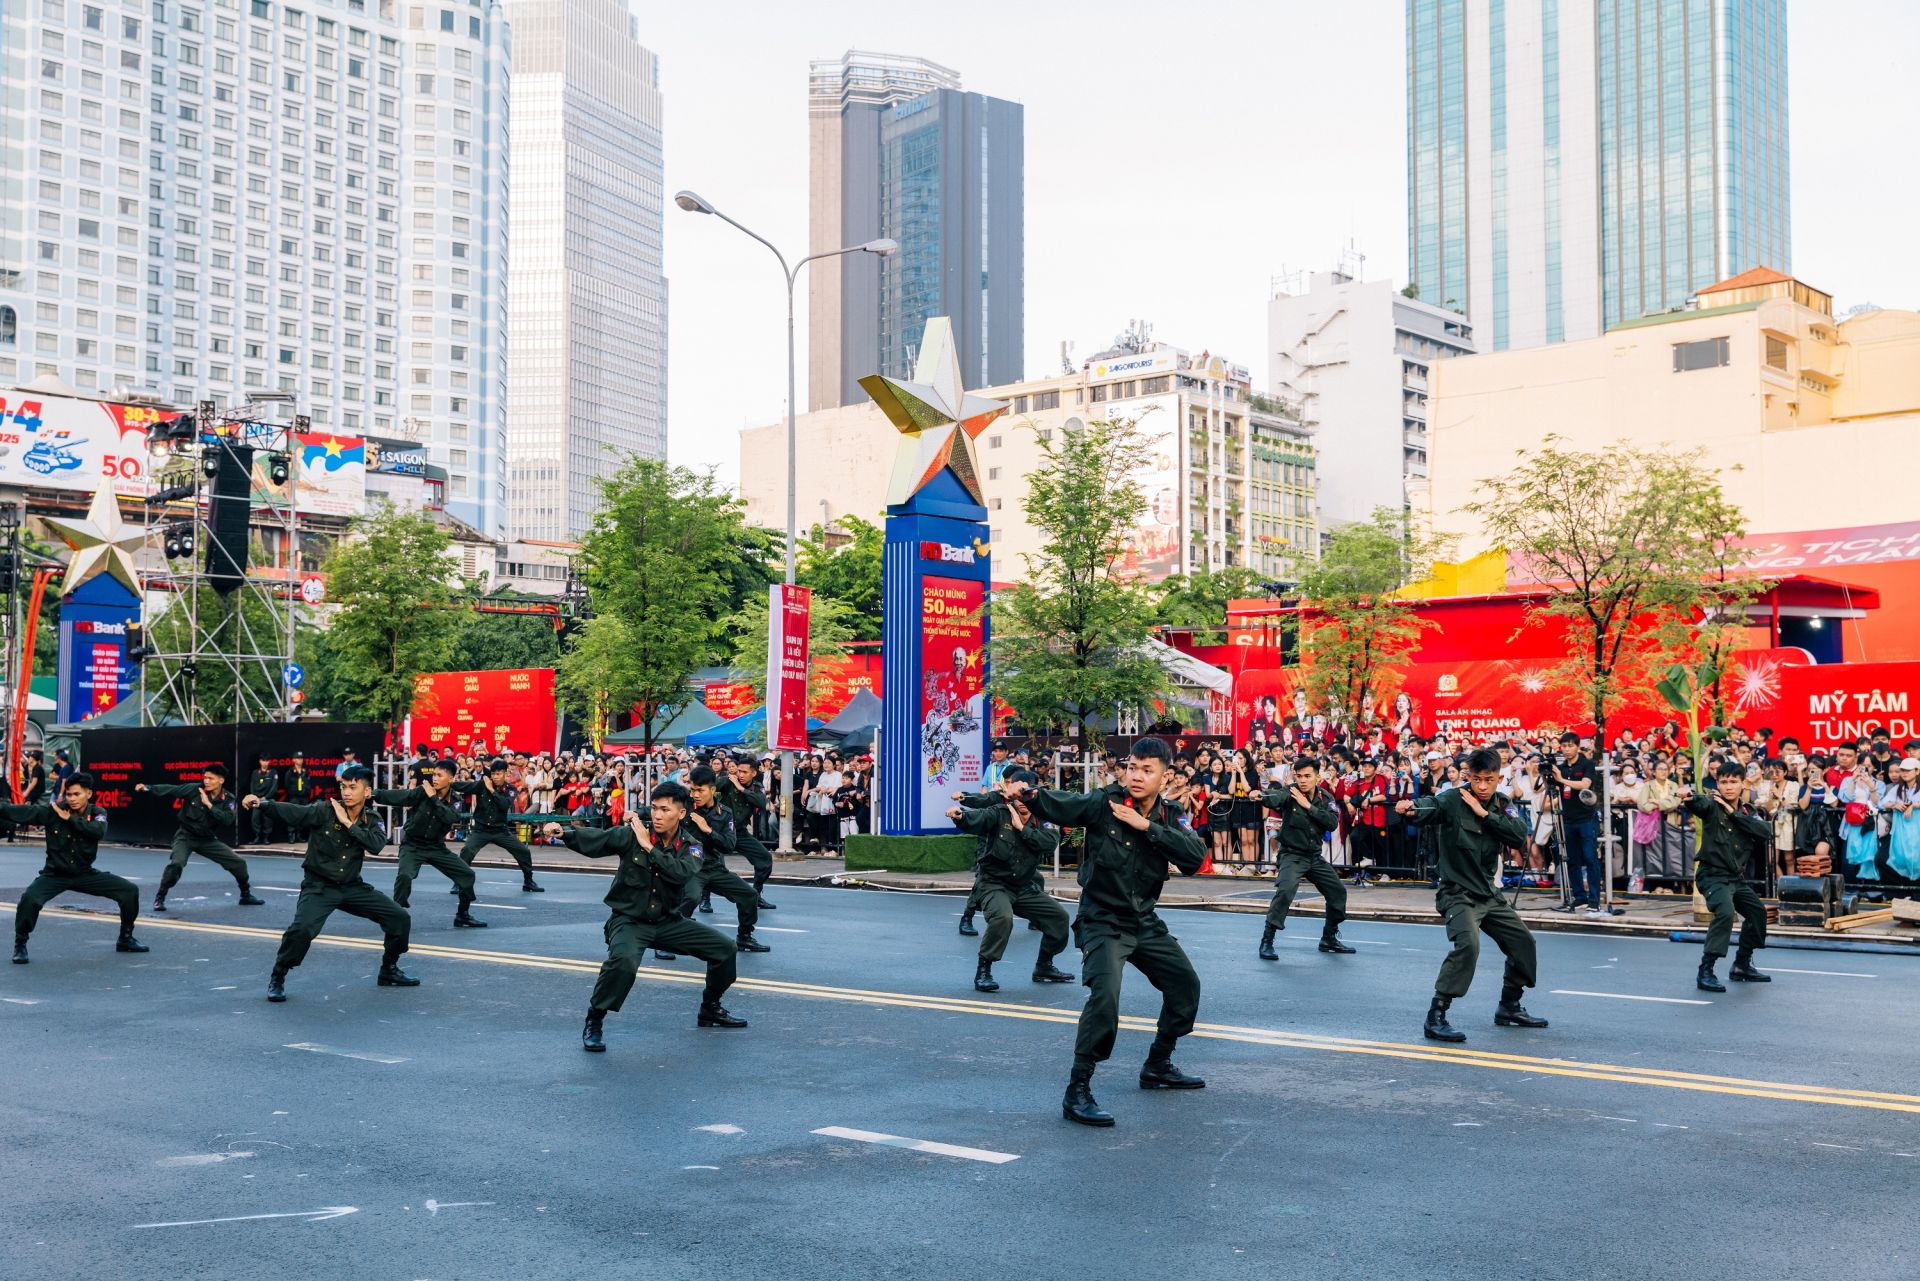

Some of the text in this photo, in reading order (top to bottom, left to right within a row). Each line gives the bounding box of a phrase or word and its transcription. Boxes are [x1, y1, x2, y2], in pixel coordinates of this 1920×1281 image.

[386, 452, 426, 465] SAIGON
[102, 454, 141, 479] 50
[919, 540, 976, 563] HDBank
[923, 587, 967, 599] CHÀO MỪNG
[923, 599, 967, 616] 50 NĂM
[75, 621, 126, 635] HDBank
[509, 673, 529, 682] NƯỚC
[847, 675, 872, 686] NƯỚC
[509, 682, 531, 692] MẠNH
[1809, 688, 1908, 714] MỸ TÂM
[1435, 706, 1493, 717] GALA ÂM NHẠC
[1470, 717, 1521, 730] QUANG
[1809, 715, 1882, 741] TÙNG
